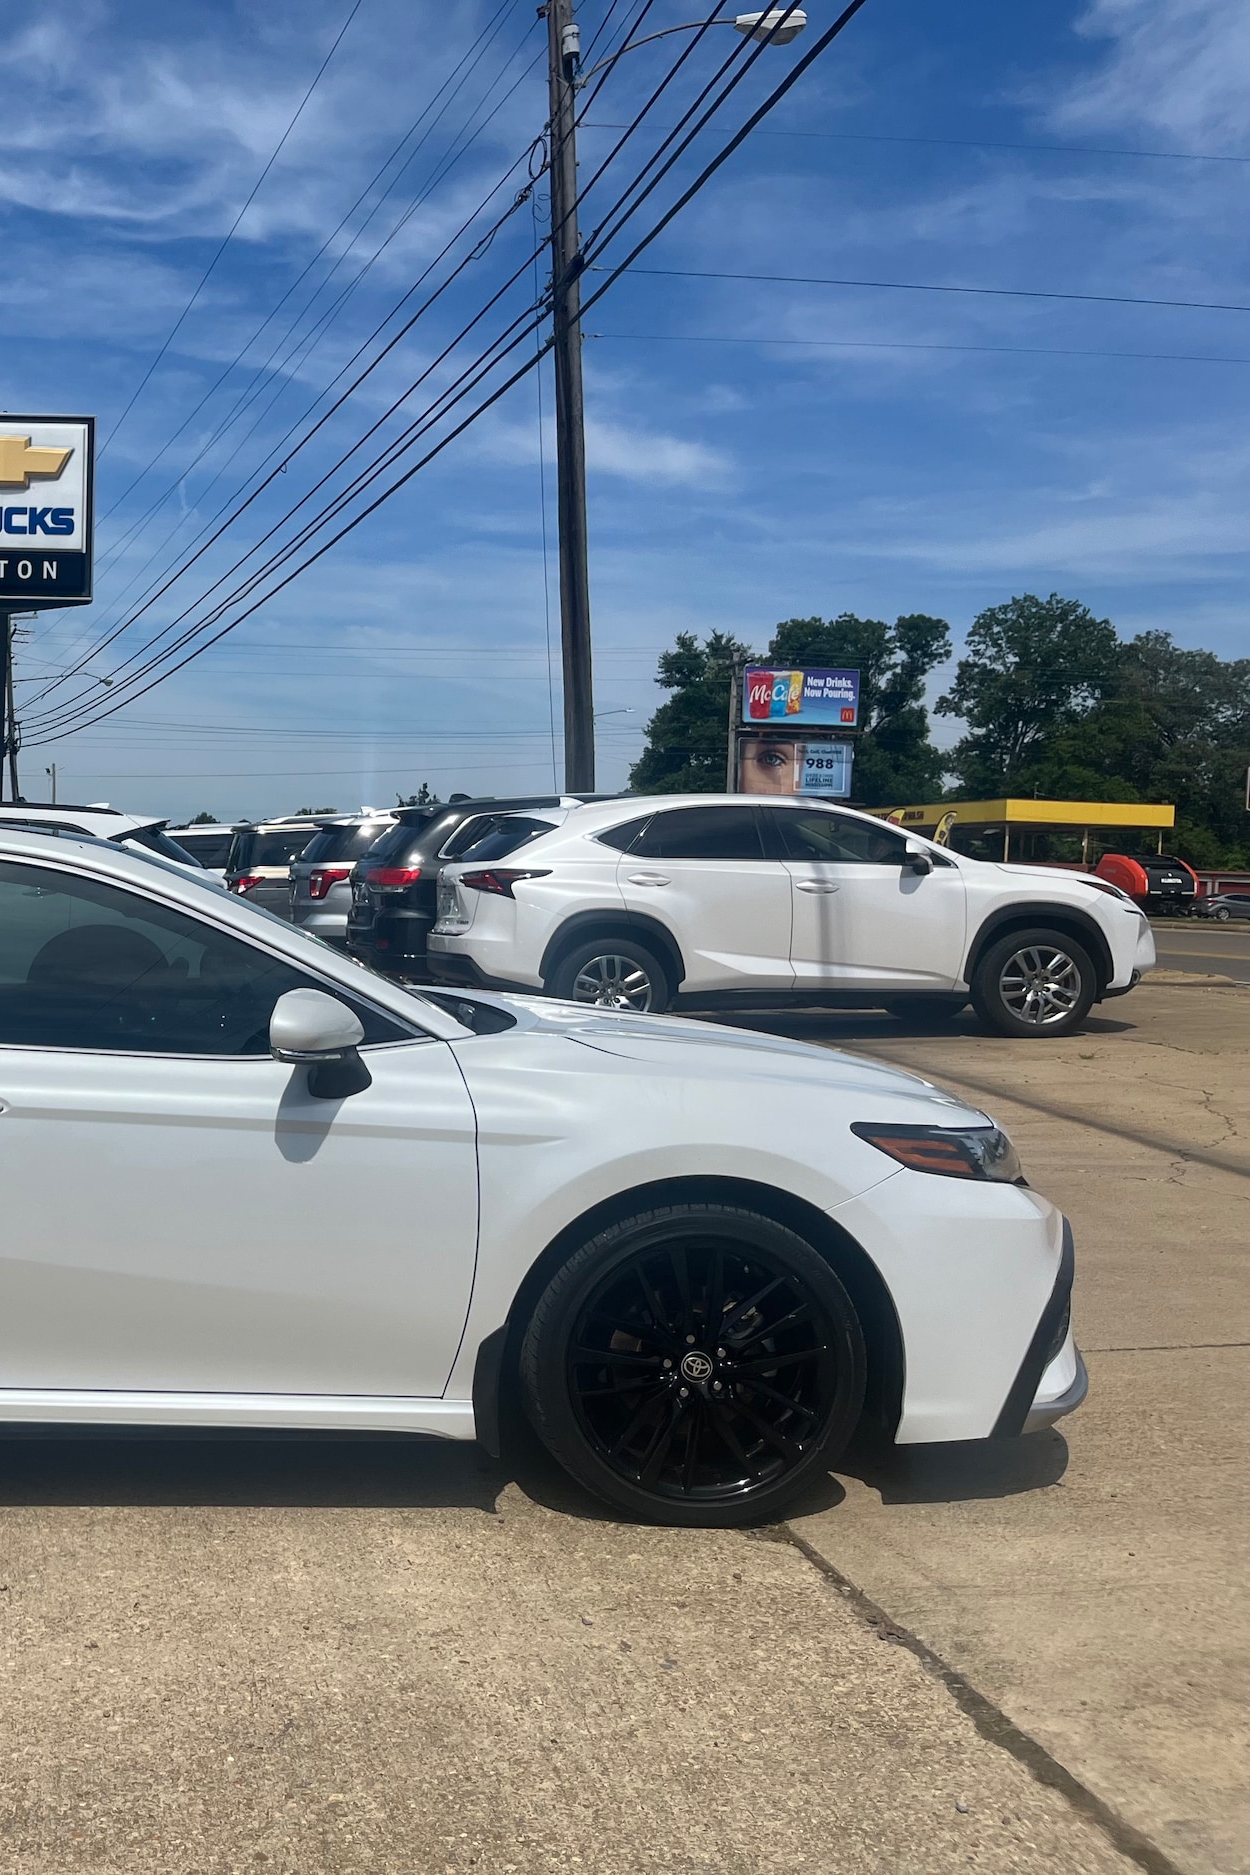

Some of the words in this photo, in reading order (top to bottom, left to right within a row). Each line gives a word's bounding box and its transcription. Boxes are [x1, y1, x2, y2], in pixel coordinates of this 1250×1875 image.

[807, 676, 824, 687] New
[826, 677, 853, 688] Drinks.
[804, 687, 822, 698] Now
[823, 687, 855, 701] Pouring.
[806, 758, 833, 769] 988
